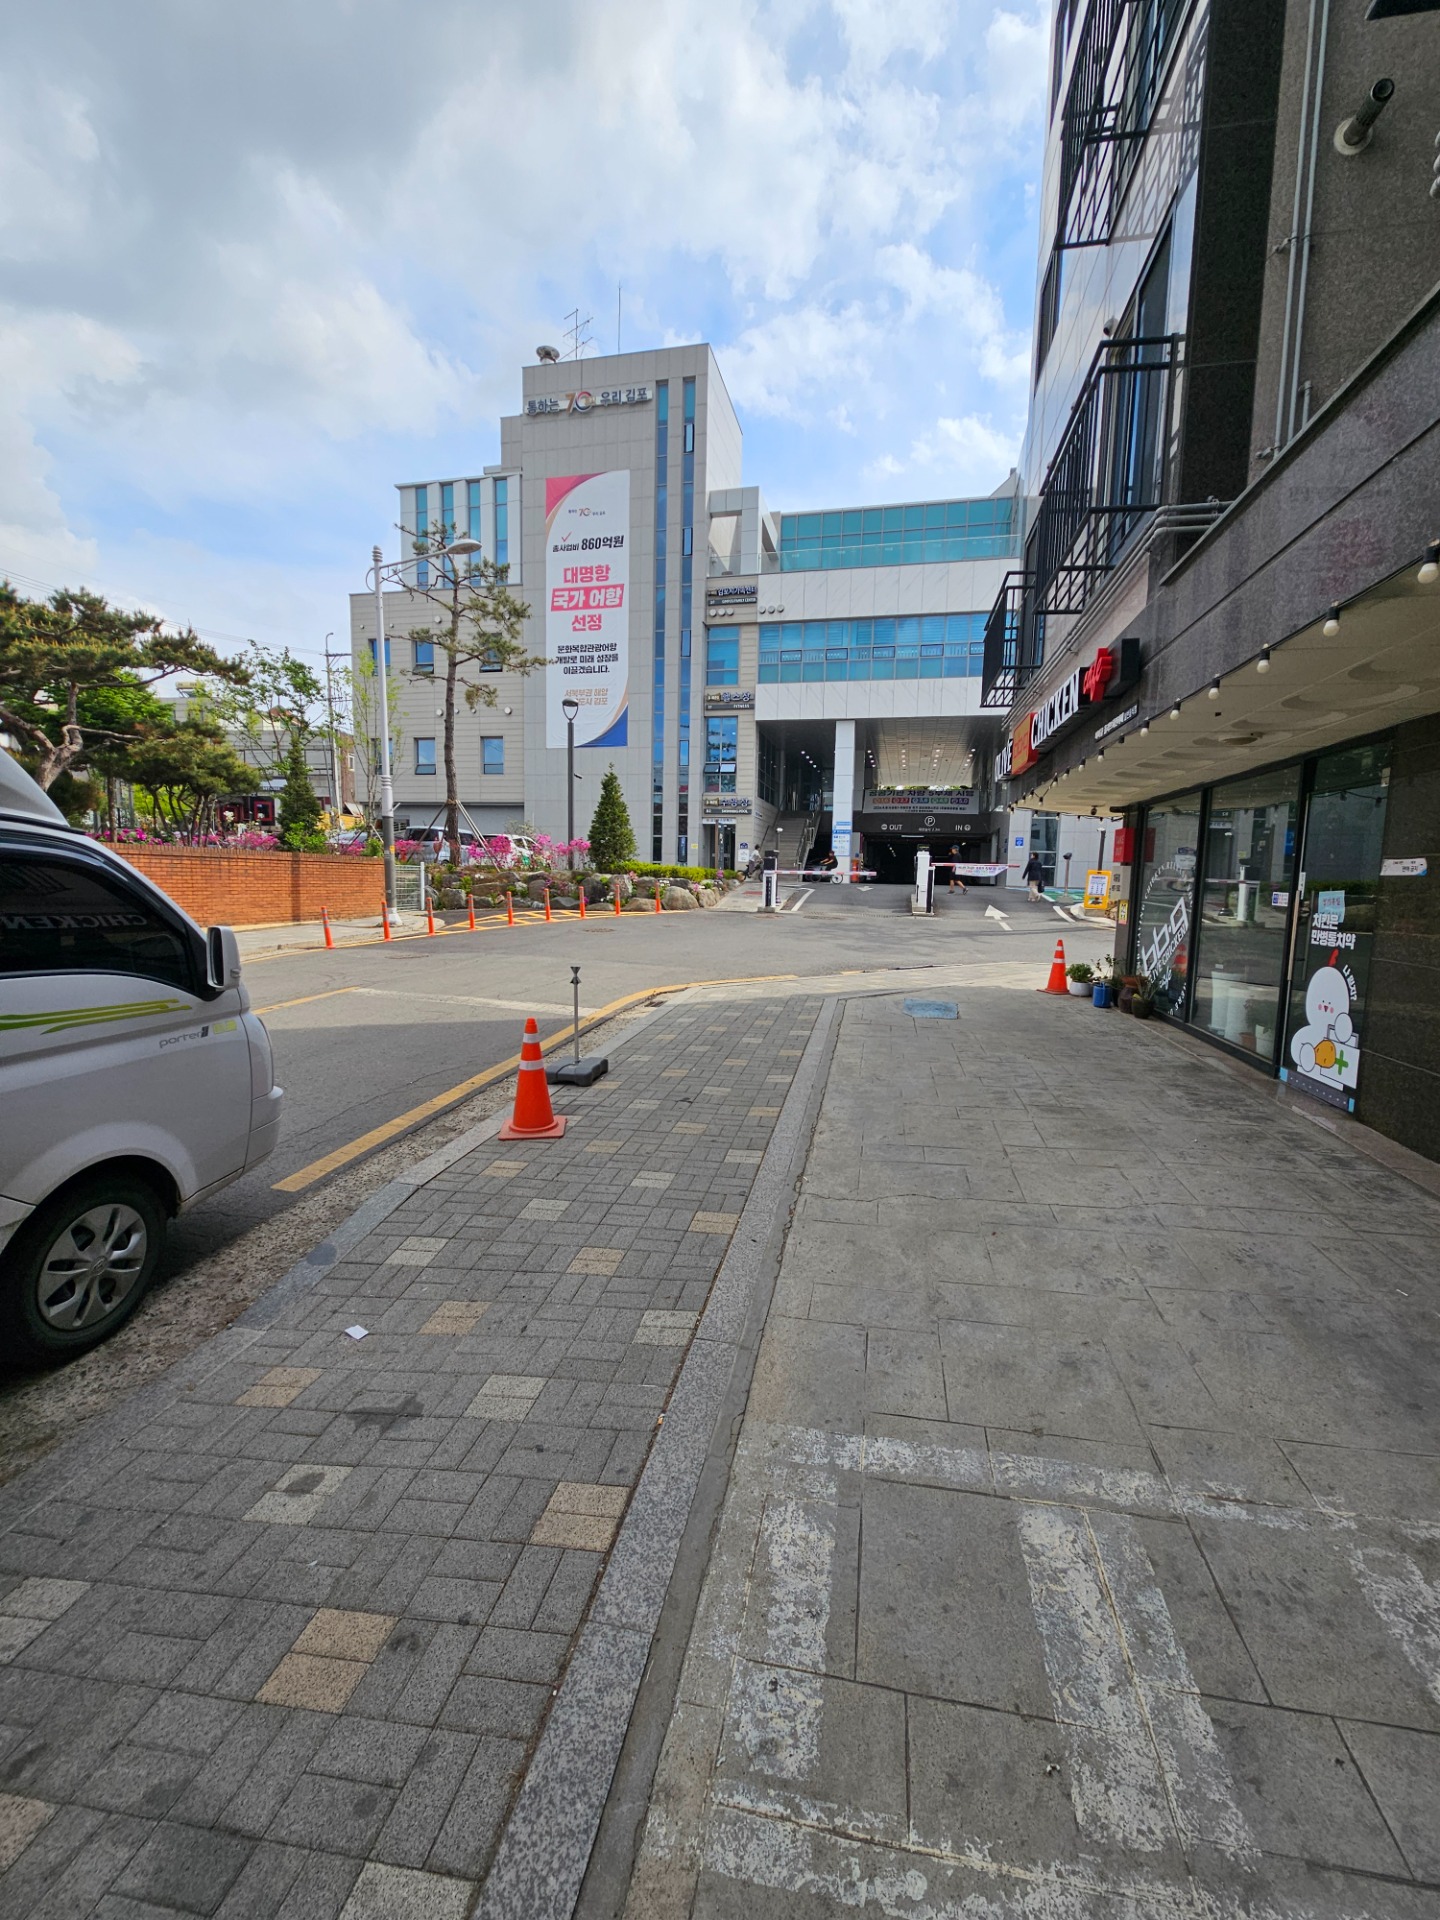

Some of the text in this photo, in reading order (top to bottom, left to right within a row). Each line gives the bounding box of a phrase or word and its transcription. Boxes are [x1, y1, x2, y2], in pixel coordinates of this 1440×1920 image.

[527, 398, 560, 416] 통하는
[600, 390, 622, 406] 우리
[625, 387, 648, 404] 김포
[581, 535, 624, 550] 860억원
[563, 564, 611, 584] 대명항
[553, 587, 622, 609] 국가 어항
[571, 613, 602, 632] 선정
[580, 654, 594, 663] 미래
[596, 653, 619, 663] 성장을
[563, 665, 610, 674] 이끌겠습니다.
[1031, 667, 1080, 750] CHICKEN
[1312, 913, 1339, 930] 치킨은
[1311, 929, 1357, 950] 만병통치약
